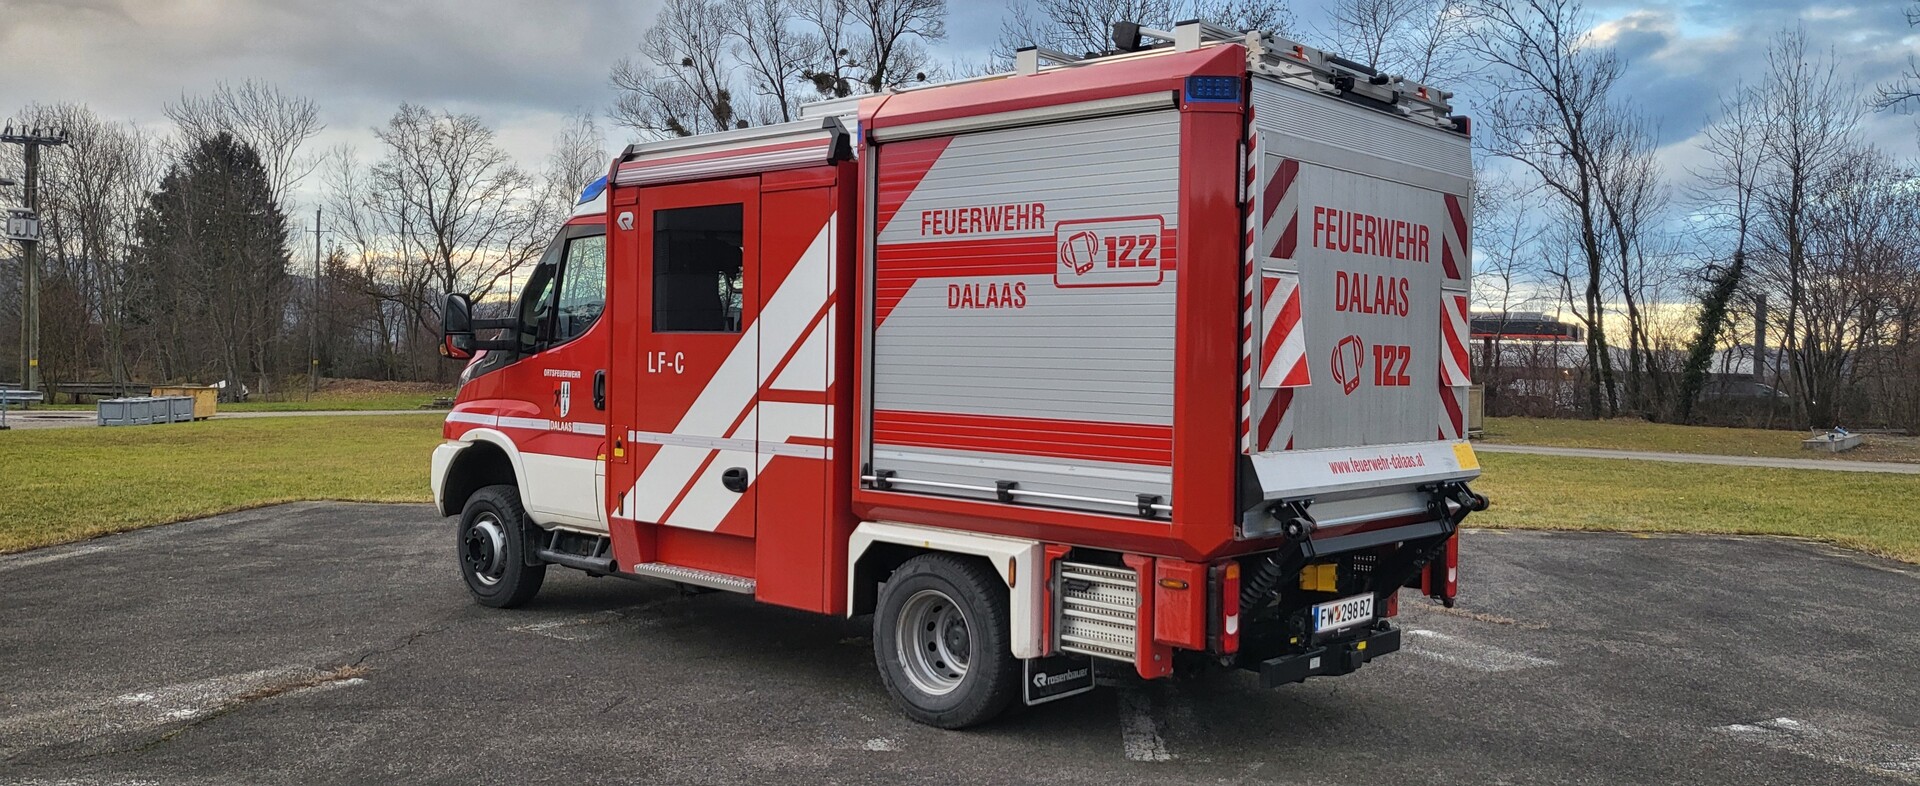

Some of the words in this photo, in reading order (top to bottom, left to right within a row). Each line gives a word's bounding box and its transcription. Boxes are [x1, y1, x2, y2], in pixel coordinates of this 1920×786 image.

[921, 203, 1046, 236] FEUERWEHR
[1313, 205, 1430, 263] FEUERWEHR
[1104, 234, 1157, 269] 122
[947, 281, 1027, 310] DALAAS
[1335, 270, 1410, 318] DALAAS
[647, 351, 685, 374] LF-C
[1372, 344, 1411, 387] 122
[550, 420, 573, 432] DALAAS
[1328, 452, 1426, 475] www.feuerwehr-dalaas.at
[1321, 606, 1334, 627] FW
